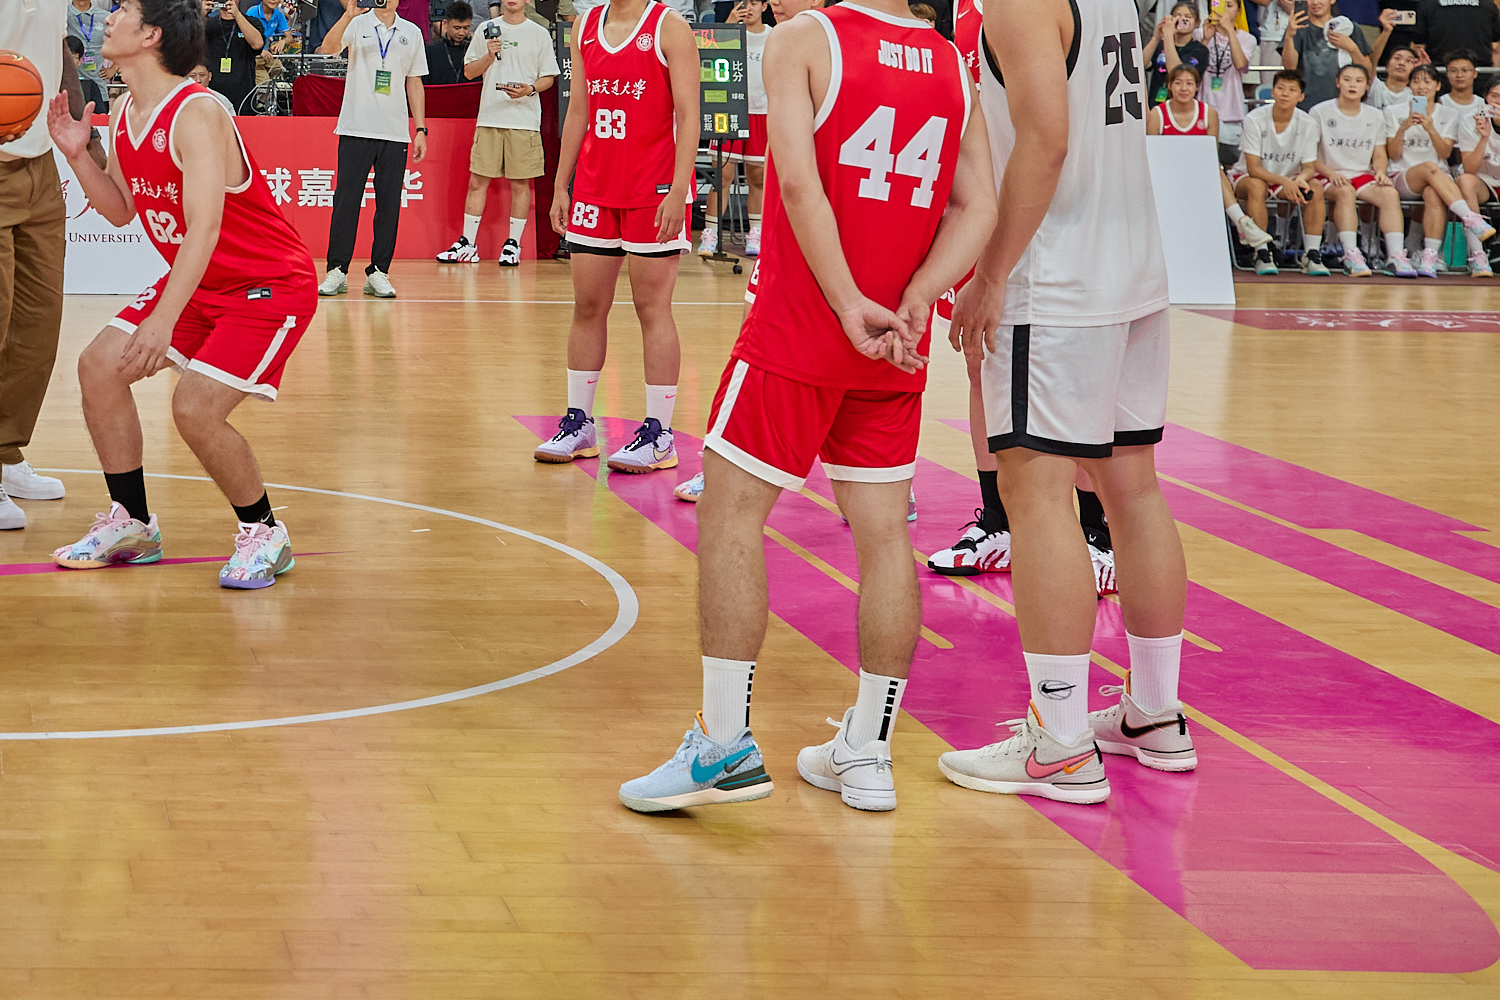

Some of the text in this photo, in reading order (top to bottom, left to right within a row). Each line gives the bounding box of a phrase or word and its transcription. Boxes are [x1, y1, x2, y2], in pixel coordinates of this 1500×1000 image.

[732, 60, 744, 82] 比分
[878, 39, 904, 70] JUST
[904, 45, 921, 73] DO
[921, 47, 933, 74] IT
[1101, 31, 1143, 126] 25
[595, 108, 627, 140] 83
[714, 113, 727, 133] 0
[839, 105, 948, 209] 44
[145, 209, 184, 245] 62
[572, 201, 600, 230] 83
[69, 232, 142, 244] UNIVERSITY
